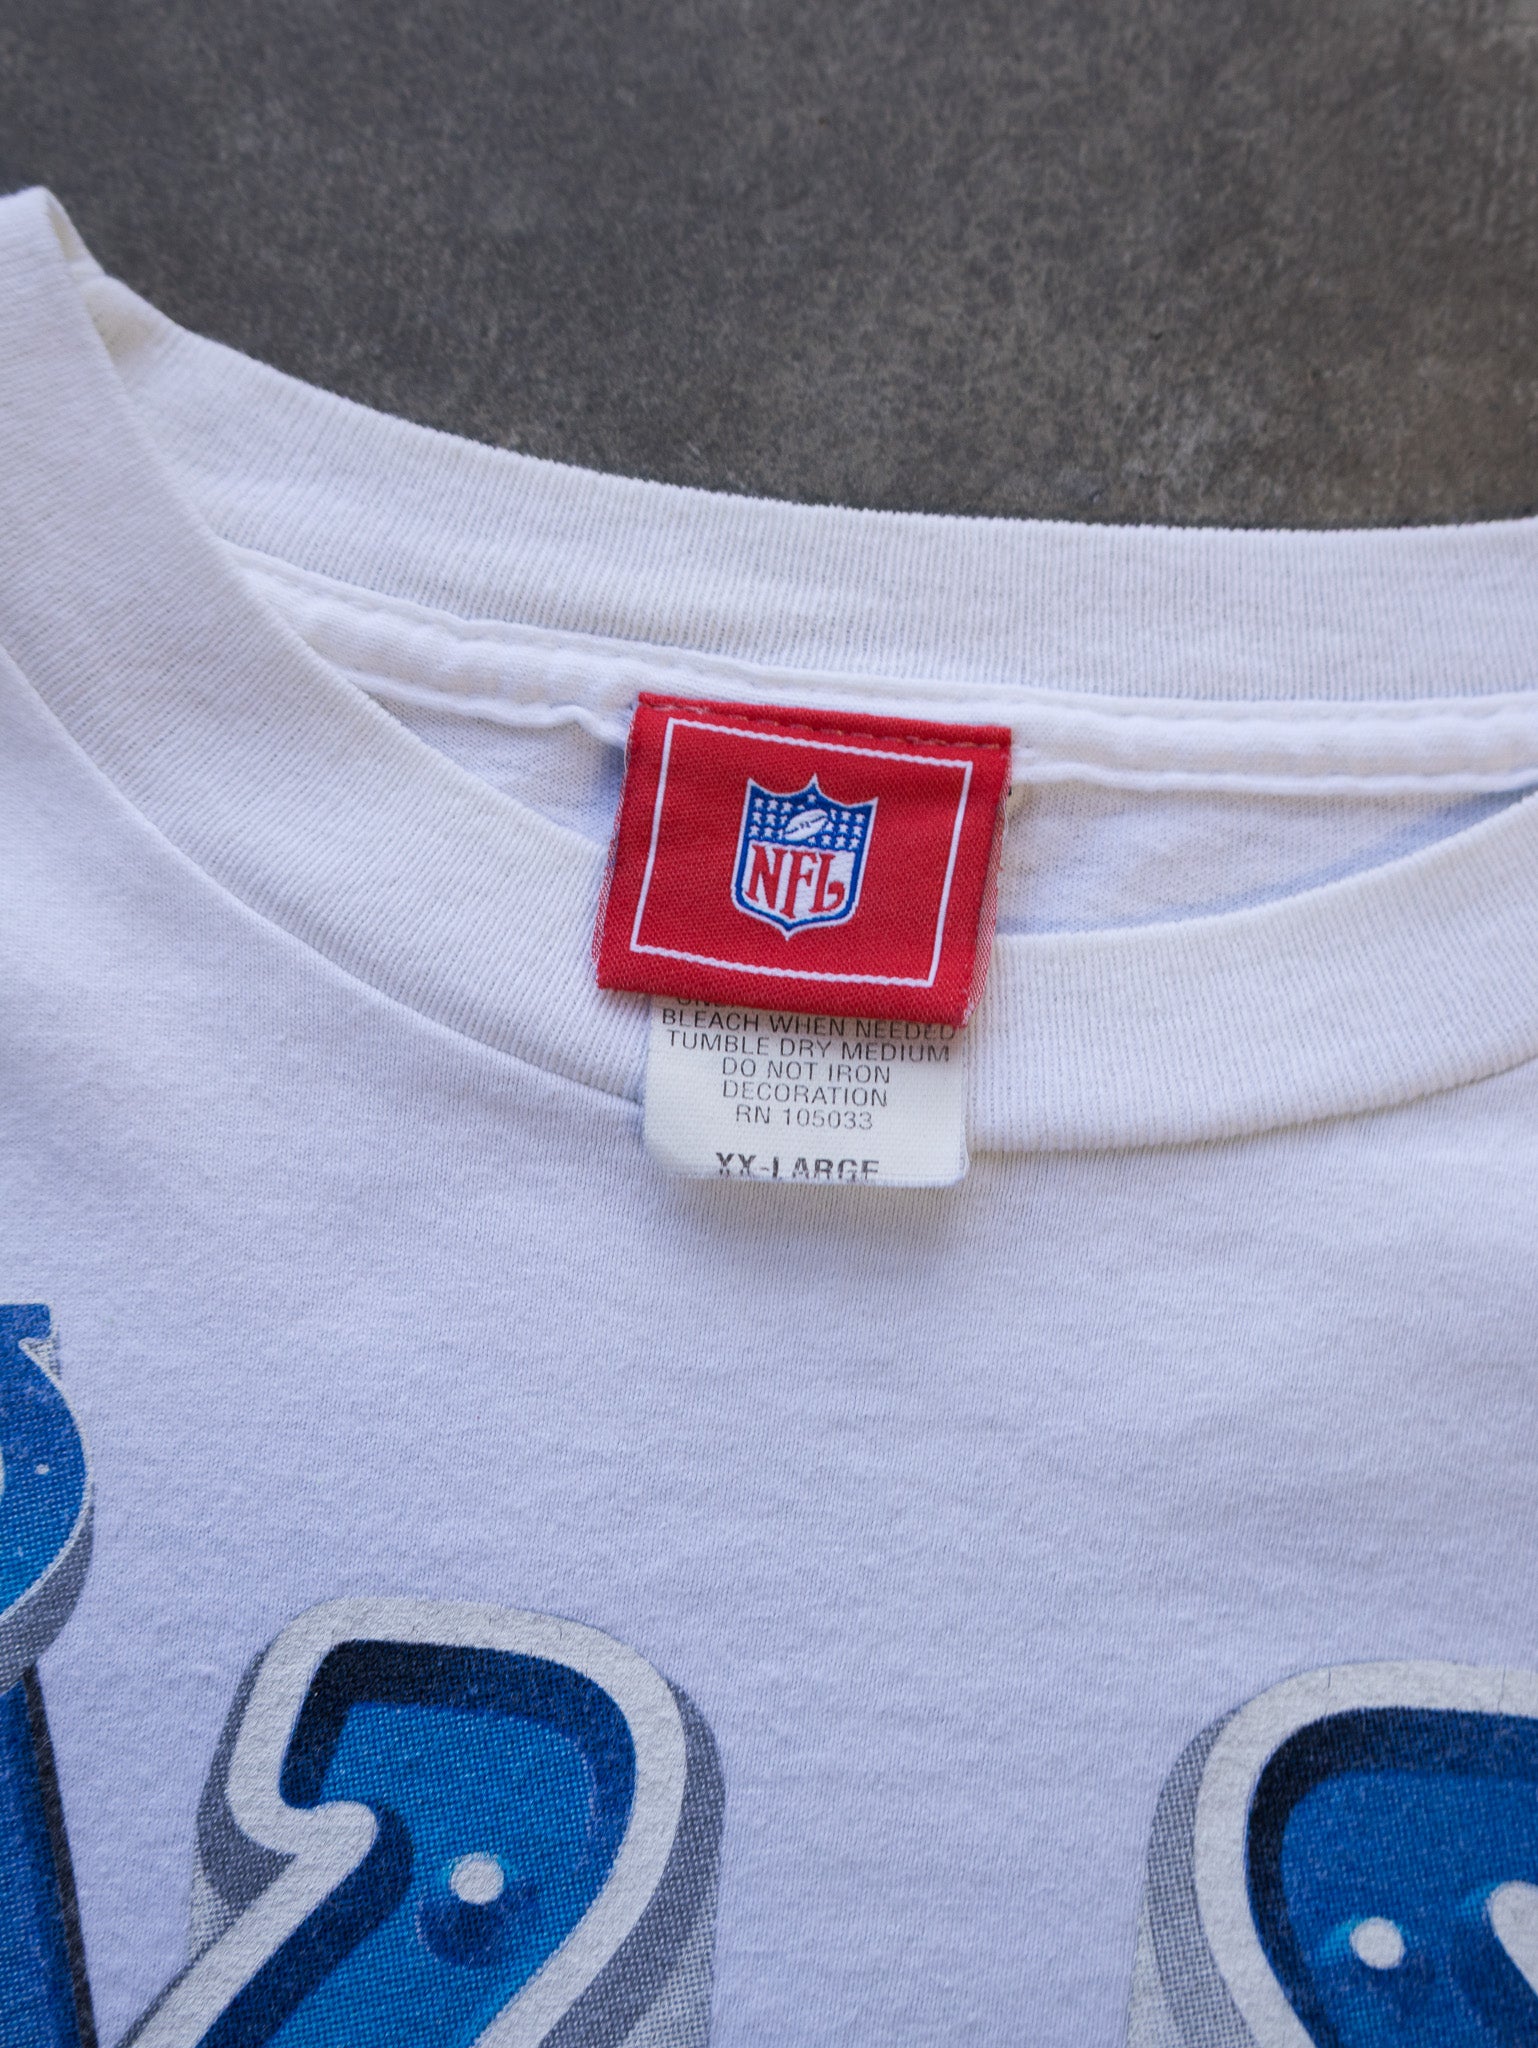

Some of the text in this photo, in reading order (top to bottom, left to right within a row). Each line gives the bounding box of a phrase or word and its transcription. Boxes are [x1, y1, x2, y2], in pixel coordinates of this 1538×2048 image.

[745, 845, 845, 919] NFL
[662, 1007, 956, 1041] BLEACH WHEN NEEDED
[667, 1029, 950, 1062] TUMBLE DRY MEDIUM
[722, 1056, 890, 1084] DO NOT IRON
[722, 1080, 888, 1107] DECORATION
[736, 1104, 873, 1130] RN 105033
